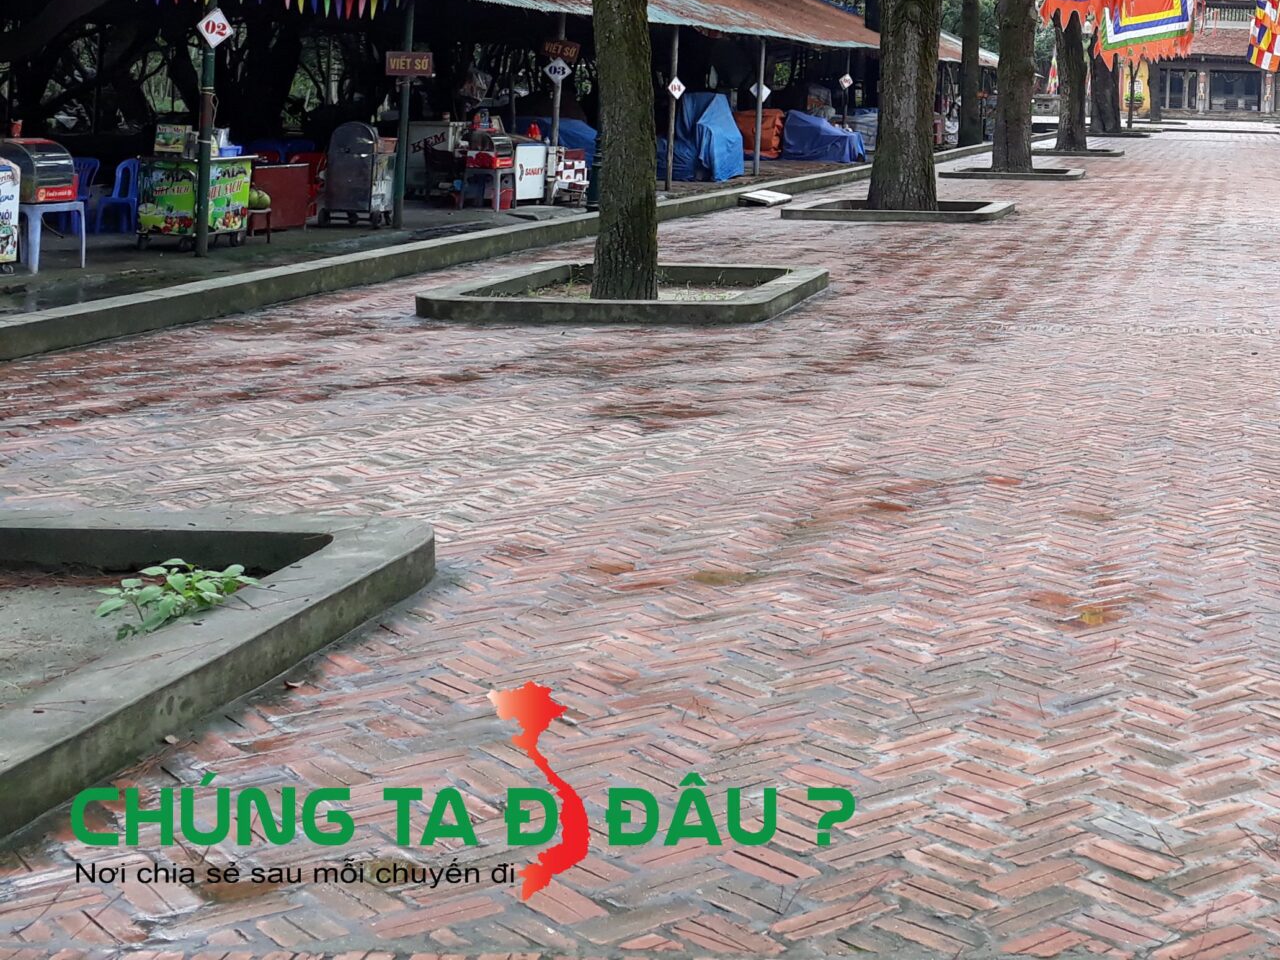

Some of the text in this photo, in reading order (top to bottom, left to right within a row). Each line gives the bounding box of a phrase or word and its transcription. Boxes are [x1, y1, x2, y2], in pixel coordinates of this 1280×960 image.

[204, 19, 227, 37] 02
[389, 56, 412, 70] VIẾT
[549, 65, 566, 76] 03
